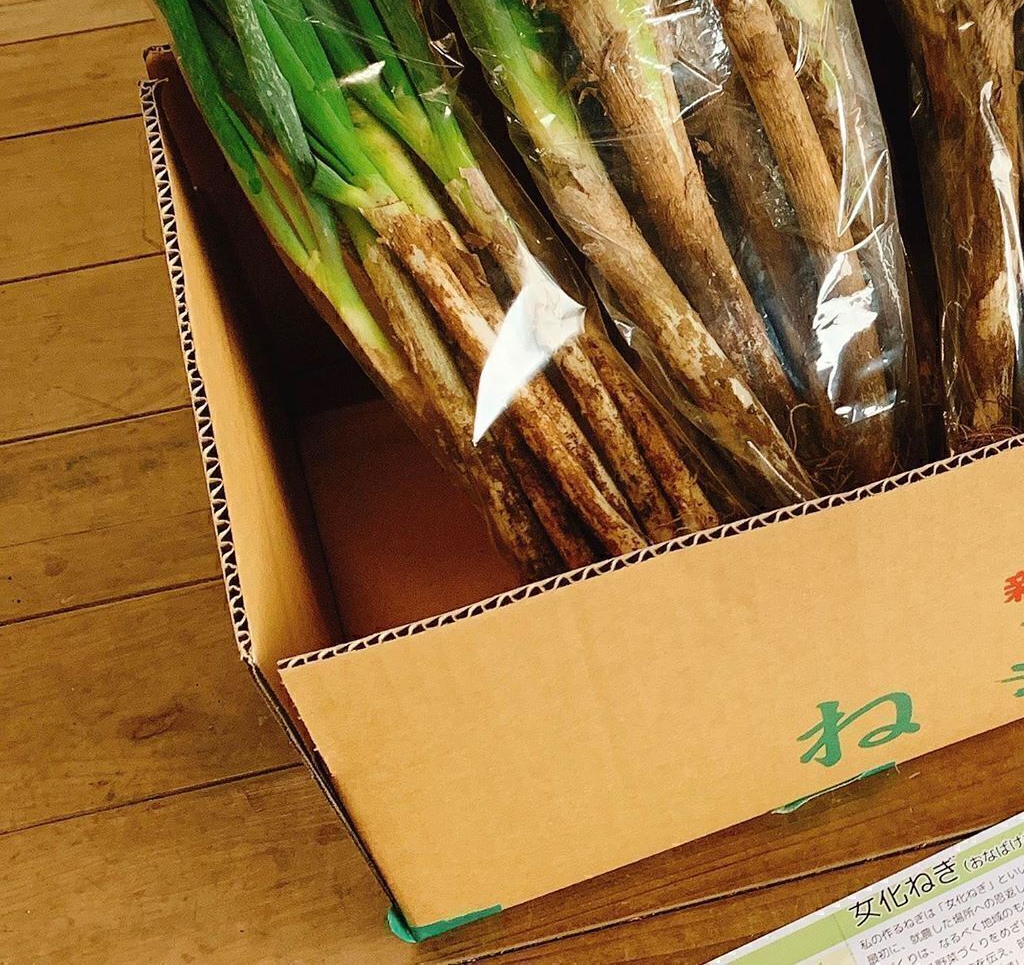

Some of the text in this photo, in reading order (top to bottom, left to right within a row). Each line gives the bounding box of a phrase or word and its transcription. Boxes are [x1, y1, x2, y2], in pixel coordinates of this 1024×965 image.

[796, 692, 920, 767] ね
[849, 856, 959, 926] 女化ねぎ
